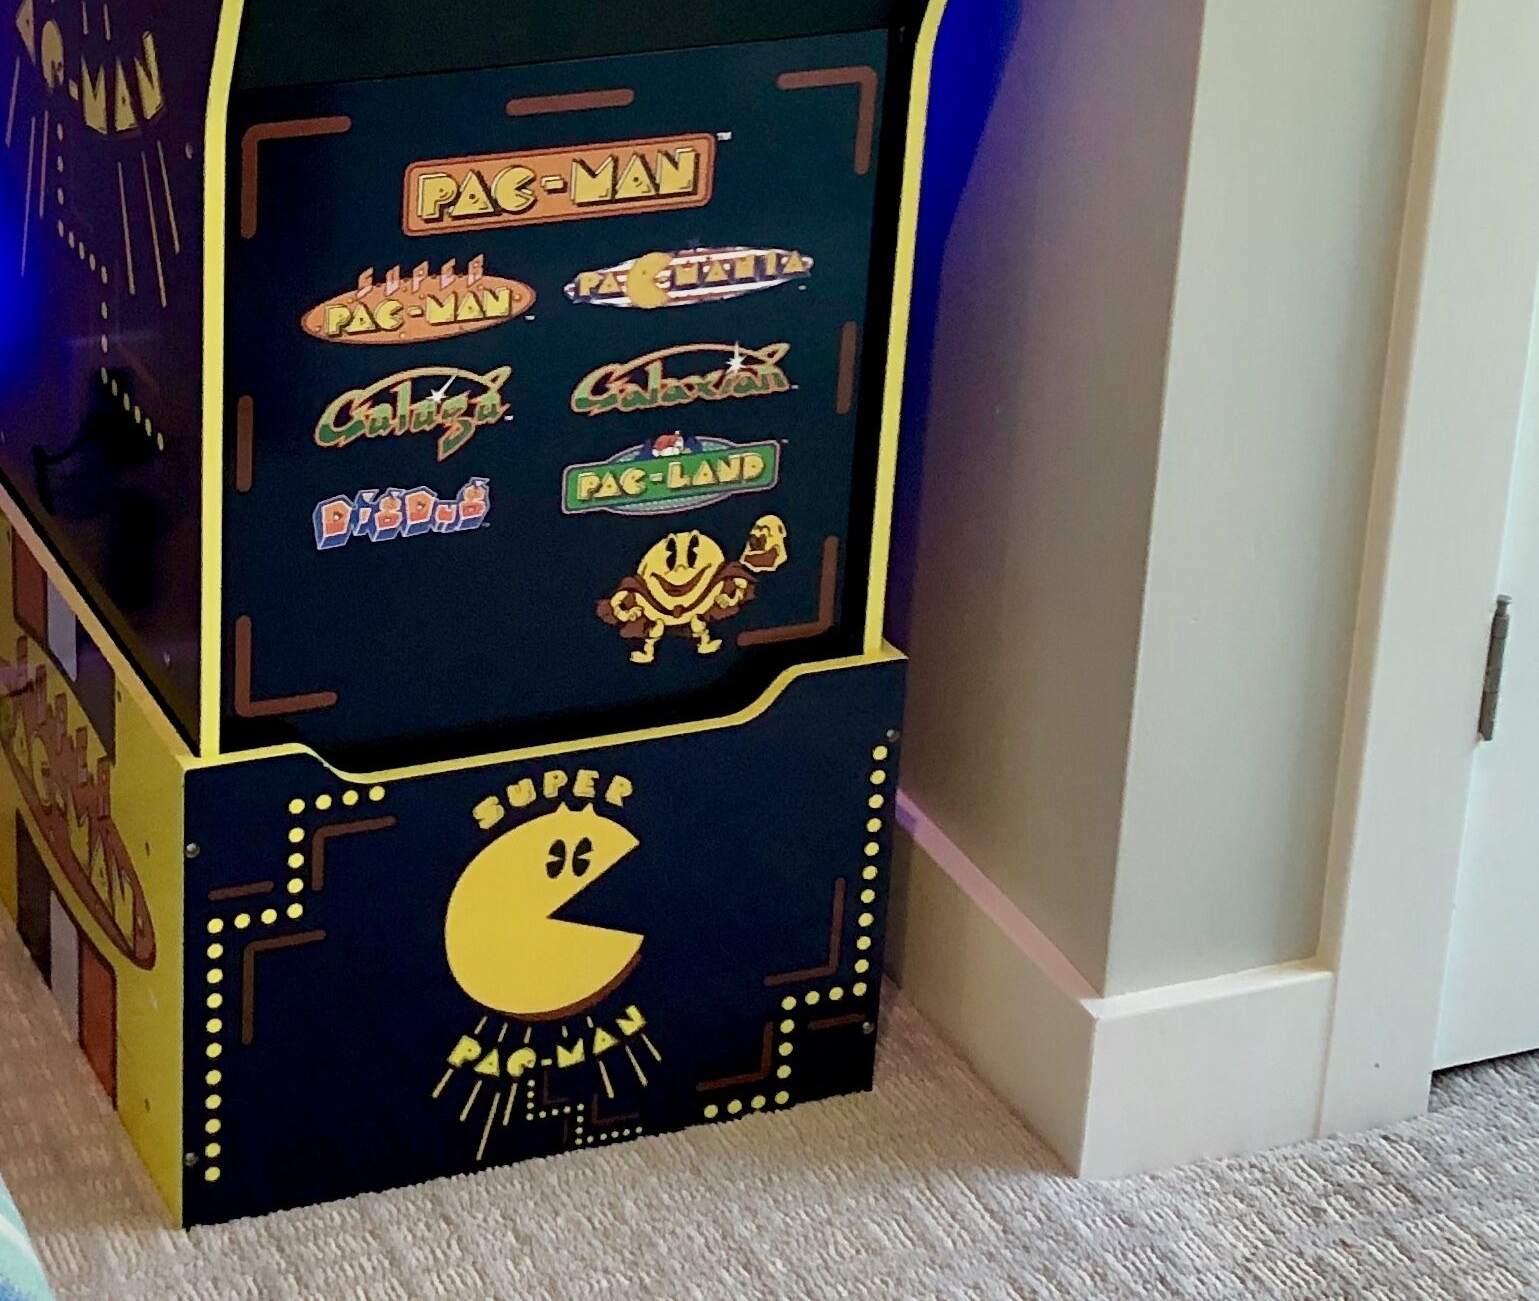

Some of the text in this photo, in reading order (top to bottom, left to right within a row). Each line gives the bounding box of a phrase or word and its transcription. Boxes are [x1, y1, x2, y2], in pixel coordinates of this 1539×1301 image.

[416, 147, 700, 222] PAC-MAN
[356, 253, 484, 300] SUPER
[324, 286, 512, 337] PAC-MAN
[571, 342, 791, 416] Galaxian
[315, 365, 512, 462] Galaga
[576, 451, 766, 501] PAC-LAND
[472, 769, 634, 830] SUPER
[447, 1005, 647, 1078] PAC-MAN
